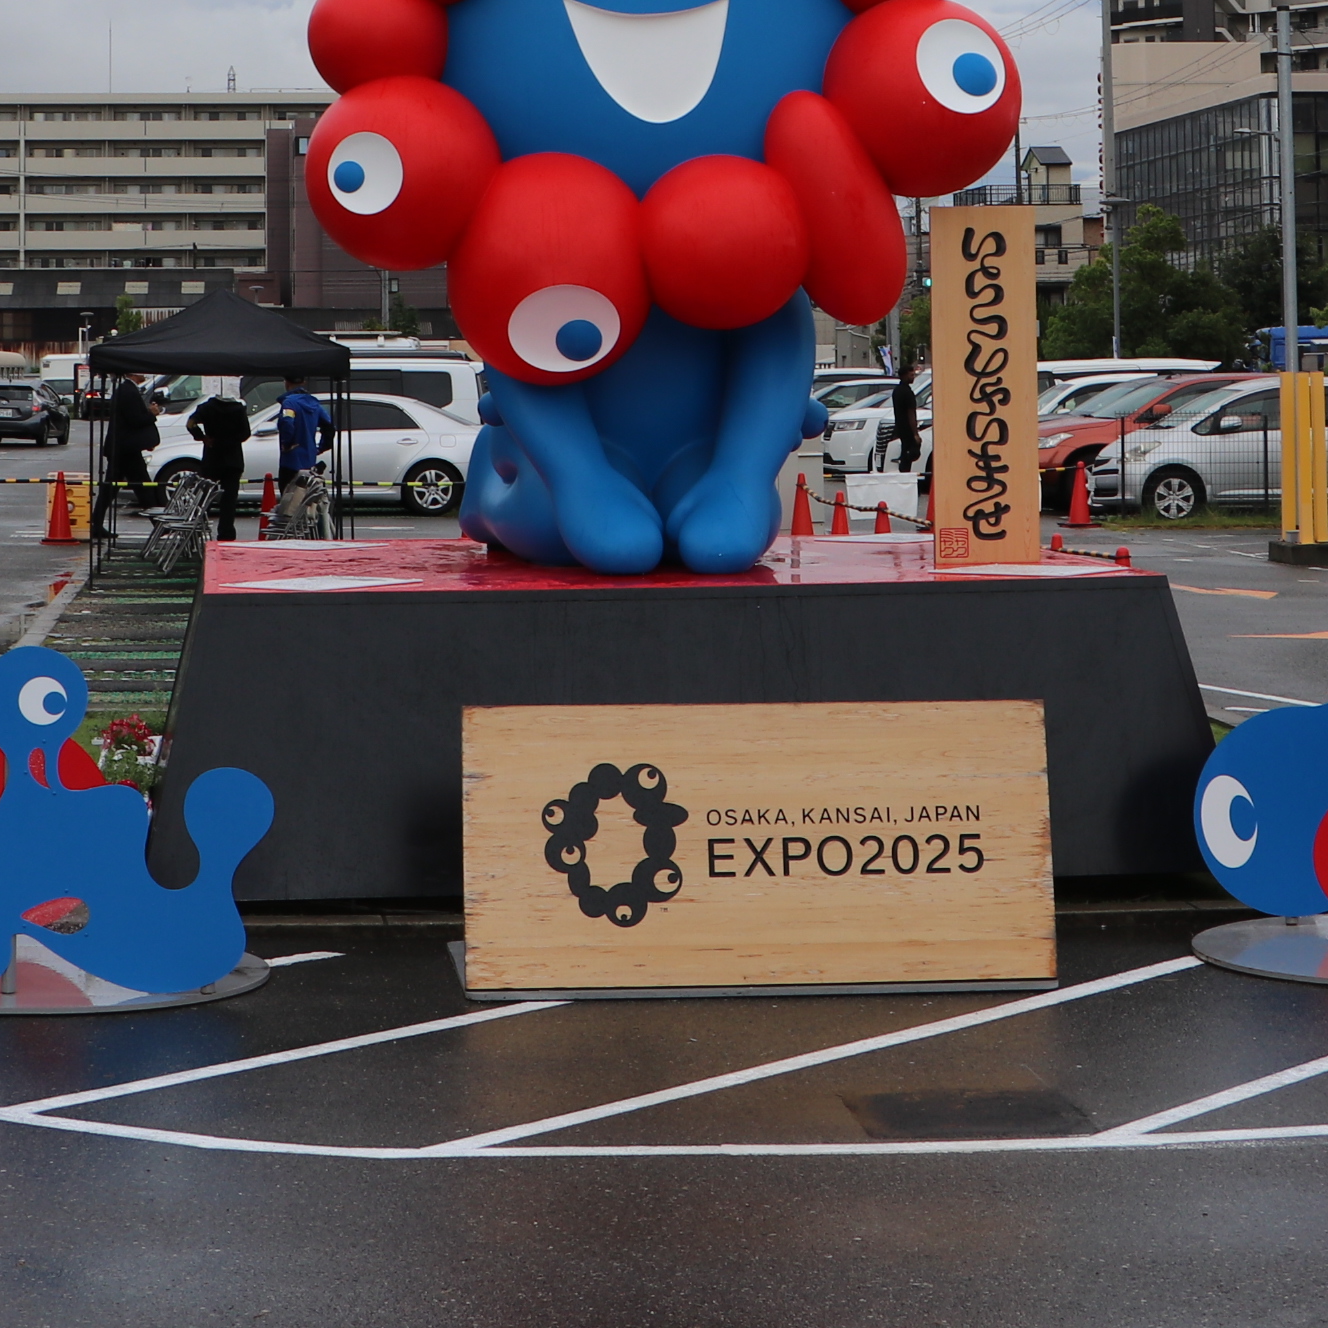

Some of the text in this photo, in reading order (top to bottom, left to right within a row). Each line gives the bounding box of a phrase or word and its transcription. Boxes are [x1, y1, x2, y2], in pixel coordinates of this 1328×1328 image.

[706, 805, 980, 827] OSAKA, KANSAI, JAPAN
[707, 833, 985, 878] EXPO2025
